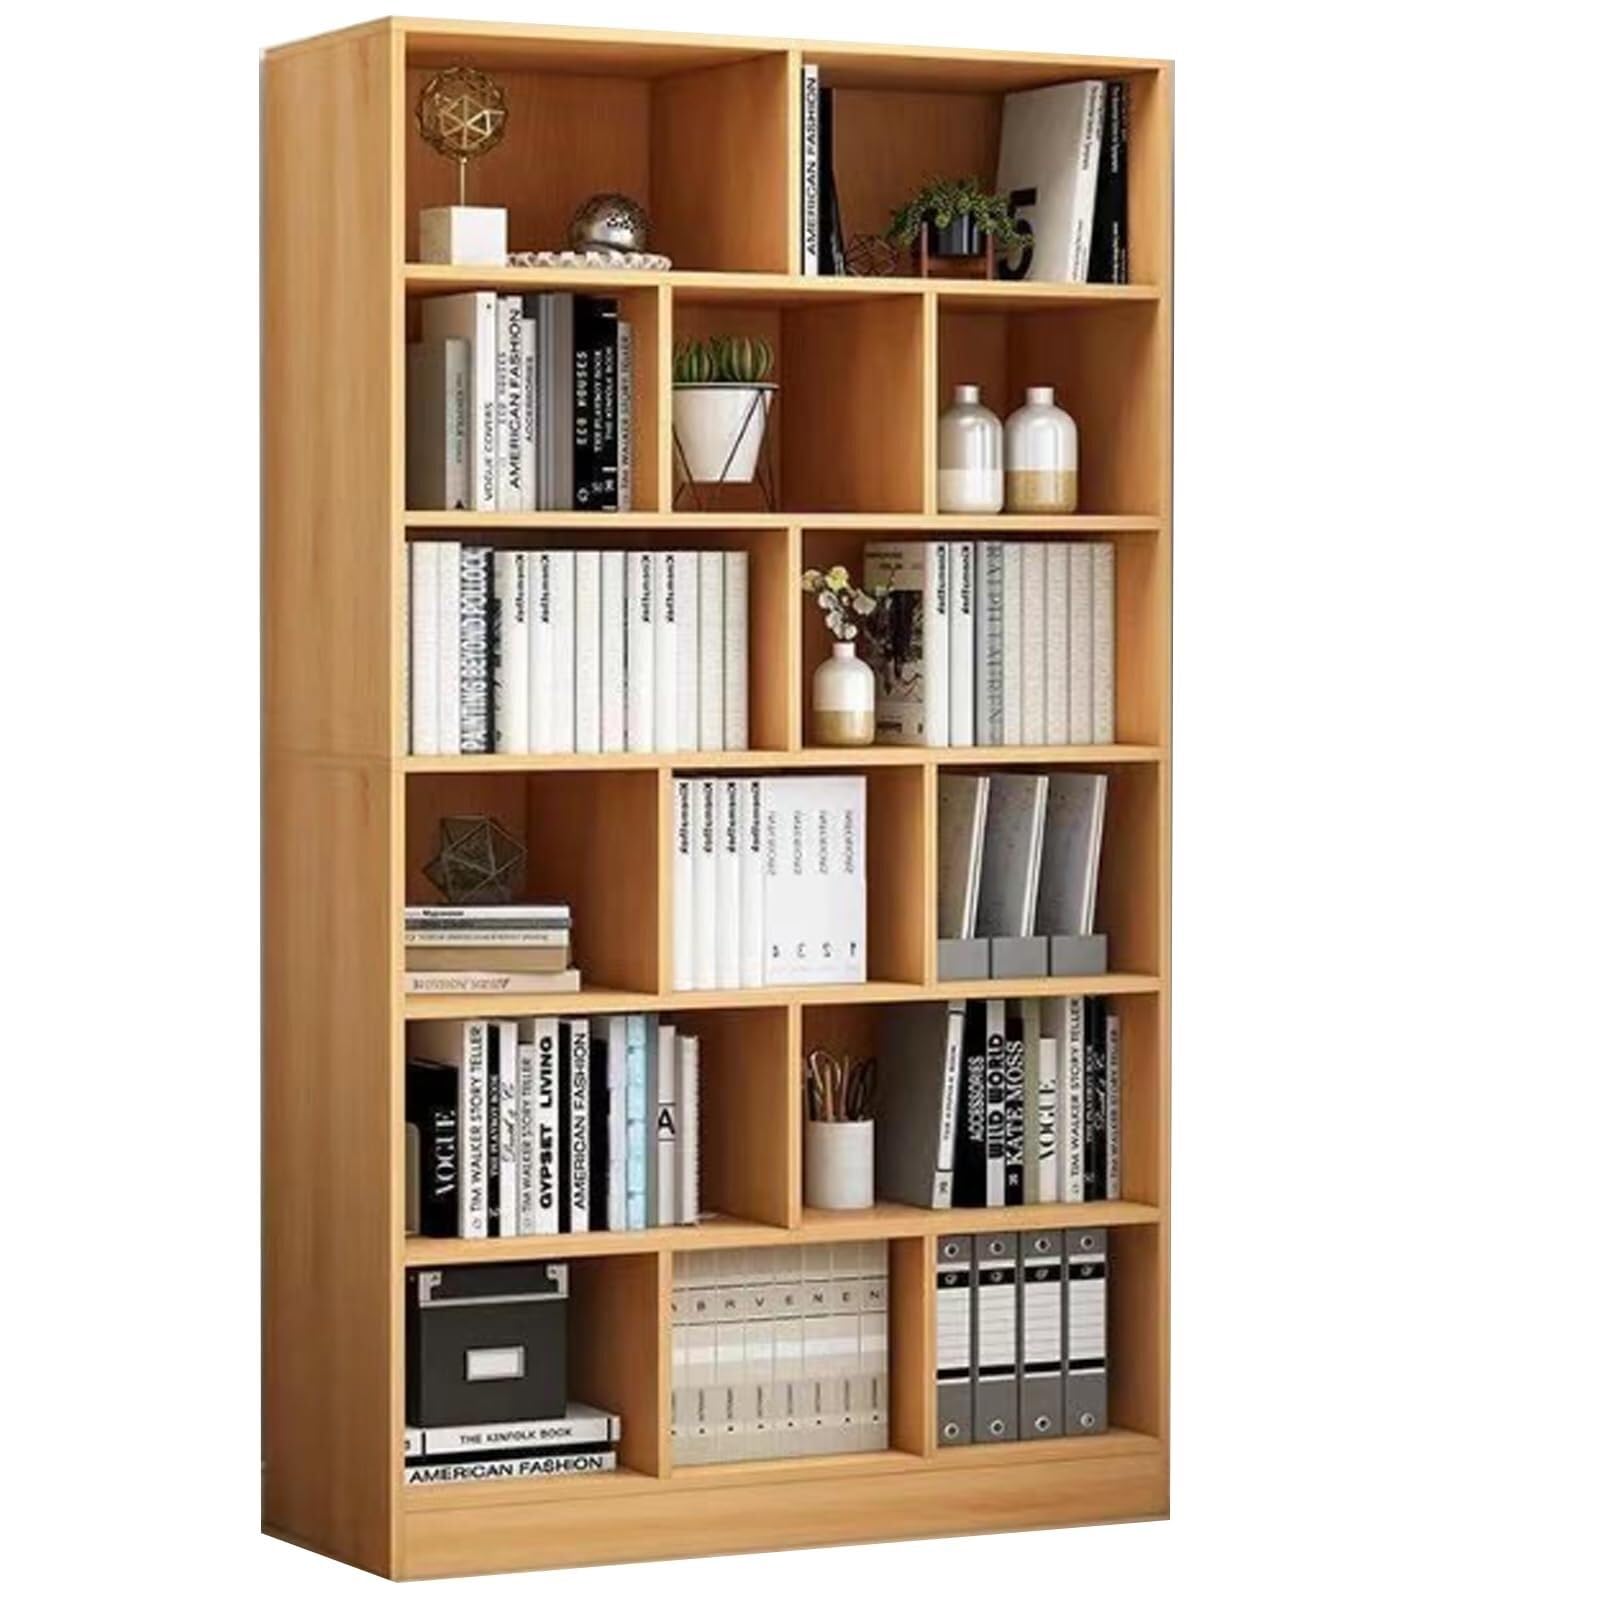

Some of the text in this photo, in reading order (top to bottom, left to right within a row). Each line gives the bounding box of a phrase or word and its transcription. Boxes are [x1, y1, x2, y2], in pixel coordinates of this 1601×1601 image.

[806, 77, 816, 256] AMERICAN FASHION
[508, 308, 521, 489] AMERICAN FASHION
[524, 356, 534, 443] ACCESSORIES
[576, 350, 588, 446] ECO HOUSES
[484, 401, 493, 501] VOGUE COVERS
[460, 547, 486, 752] PAINTING BEYOND POLLOCK
[470, 1026, 482, 1212] TIM WALKER STORY TELLER
[967, 1056, 985, 1142] ACCESSORIES
[988, 1034, 1004, 1159] WILD WORLD
[1006, 1040, 1024, 1101] MOSS
[1038, 1079, 1056, 1160] VOGUE
[1070, 999, 1080, 1177] TIM WALKER STORY TELLER
[435, 1110, 456, 1195] VOGUE
[489, 1074, 499, 1177] THE PLAYBOY BOOK
[522, 1057, 532, 1212] TIM WALKER STORY TELLER
[540, 1035, 553, 1209] GYPSET LIVING
[573, 1032, 586, 1210] AMERICAN FASHION
[657, 1108, 676, 1135] A
[1006, 1106, 1024, 1166] KATE
[755, 1297, 765, 1307] V
[409, 1455, 604, 1484] AMERICAN FASHION
[459, 1427, 573, 1446] THE KINFOLK BOOK
